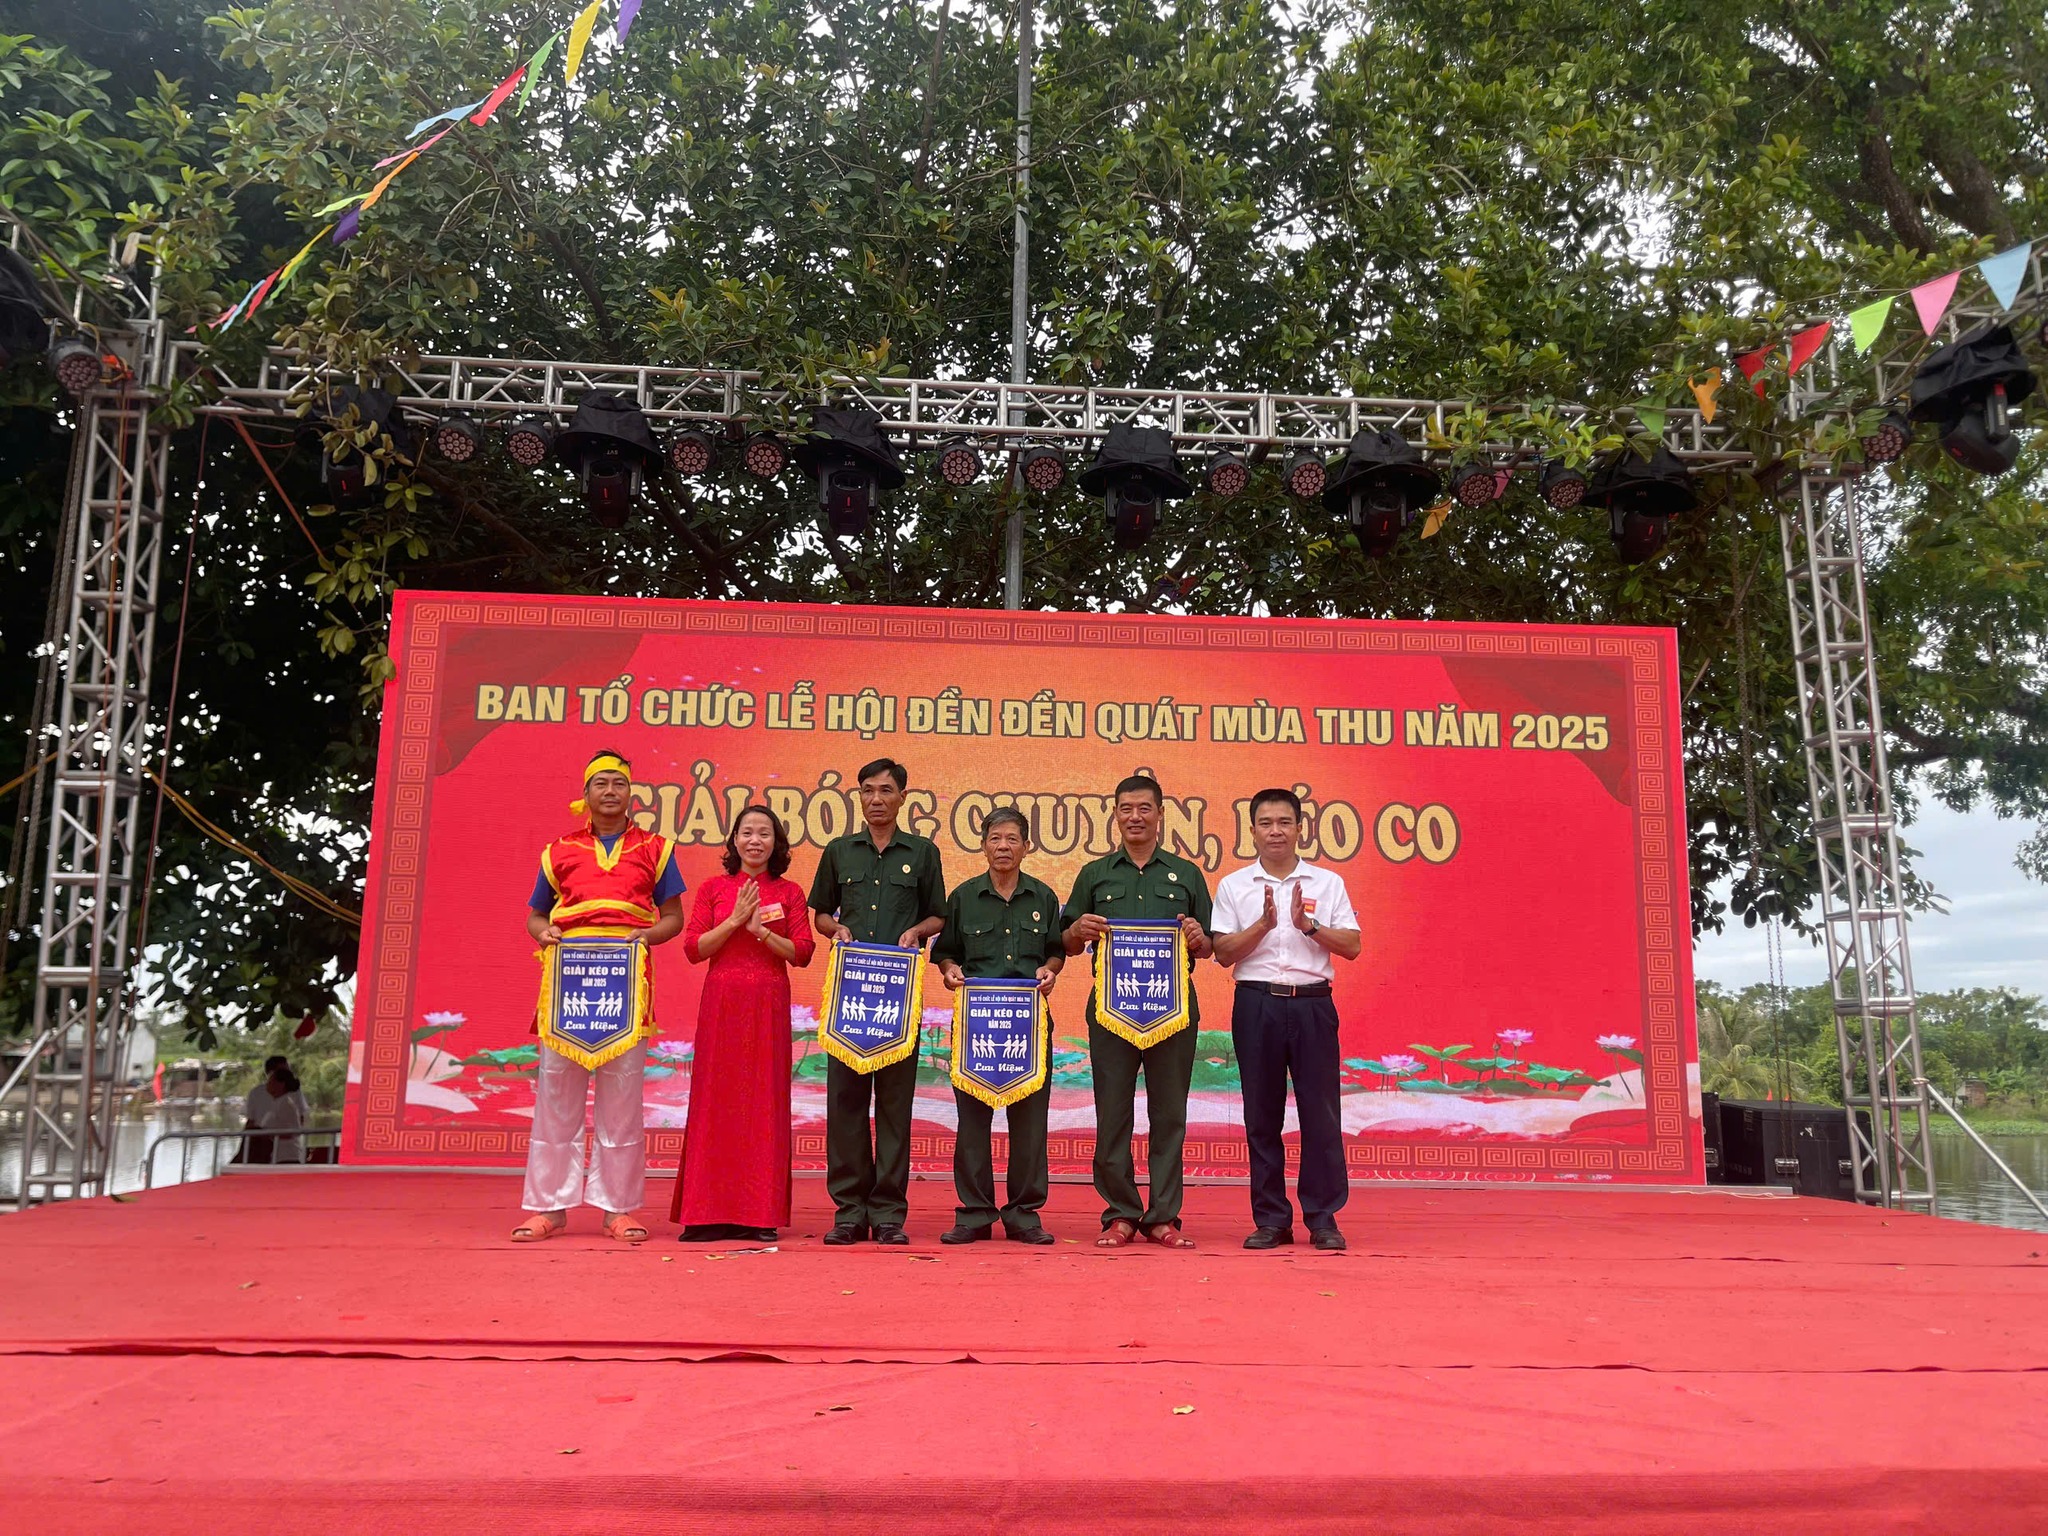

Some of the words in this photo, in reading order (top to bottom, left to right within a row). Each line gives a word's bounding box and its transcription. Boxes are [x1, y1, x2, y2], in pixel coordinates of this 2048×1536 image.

[476, 683, 567, 723] BAN
[577, 674, 633, 725] TỔ
[640, 683, 754, 728] CHỨC
[766, 680, 815, 729] LỄ
[825, 688, 898, 740] HỘI
[905, 686, 991, 736] ĐỀN
[1000, 689, 1085, 738] ĐỀN
[1097, 695, 1201, 743] QUÁT
[1211, 698, 1306, 743] MÙA
[1315, 708, 1394, 746] THU
[1404, 703, 1499, 748] NĂM
[1510, 713, 1609, 751] 2025
[764, 770, 941, 849] BÓG
[1374, 801, 1461, 865] CO
[1137, 948, 1155, 957] KÉO
[1159, 950, 1171, 958] CO
[1143, 960, 1154, 968] 2025
[589, 965, 608, 975] KÉO
[611, 967, 626, 975] CO
[594, 978, 606, 987] 2025
[868, 973, 887, 983] KÉO
[891, 975, 905, 984] CO
[873, 985, 885, 994] 2025
[994, 1008, 1012, 1017] KÉO
[1016, 1010, 1030, 1018] CO
[1143, 1003, 1168, 1013] Niệm
[590, 1021, 618, 1032] Niệm
[999, 1021, 1011, 1029] 2025
[867, 1027, 893, 1038] Niệm
[998, 1063, 1025, 1073] Niệm
